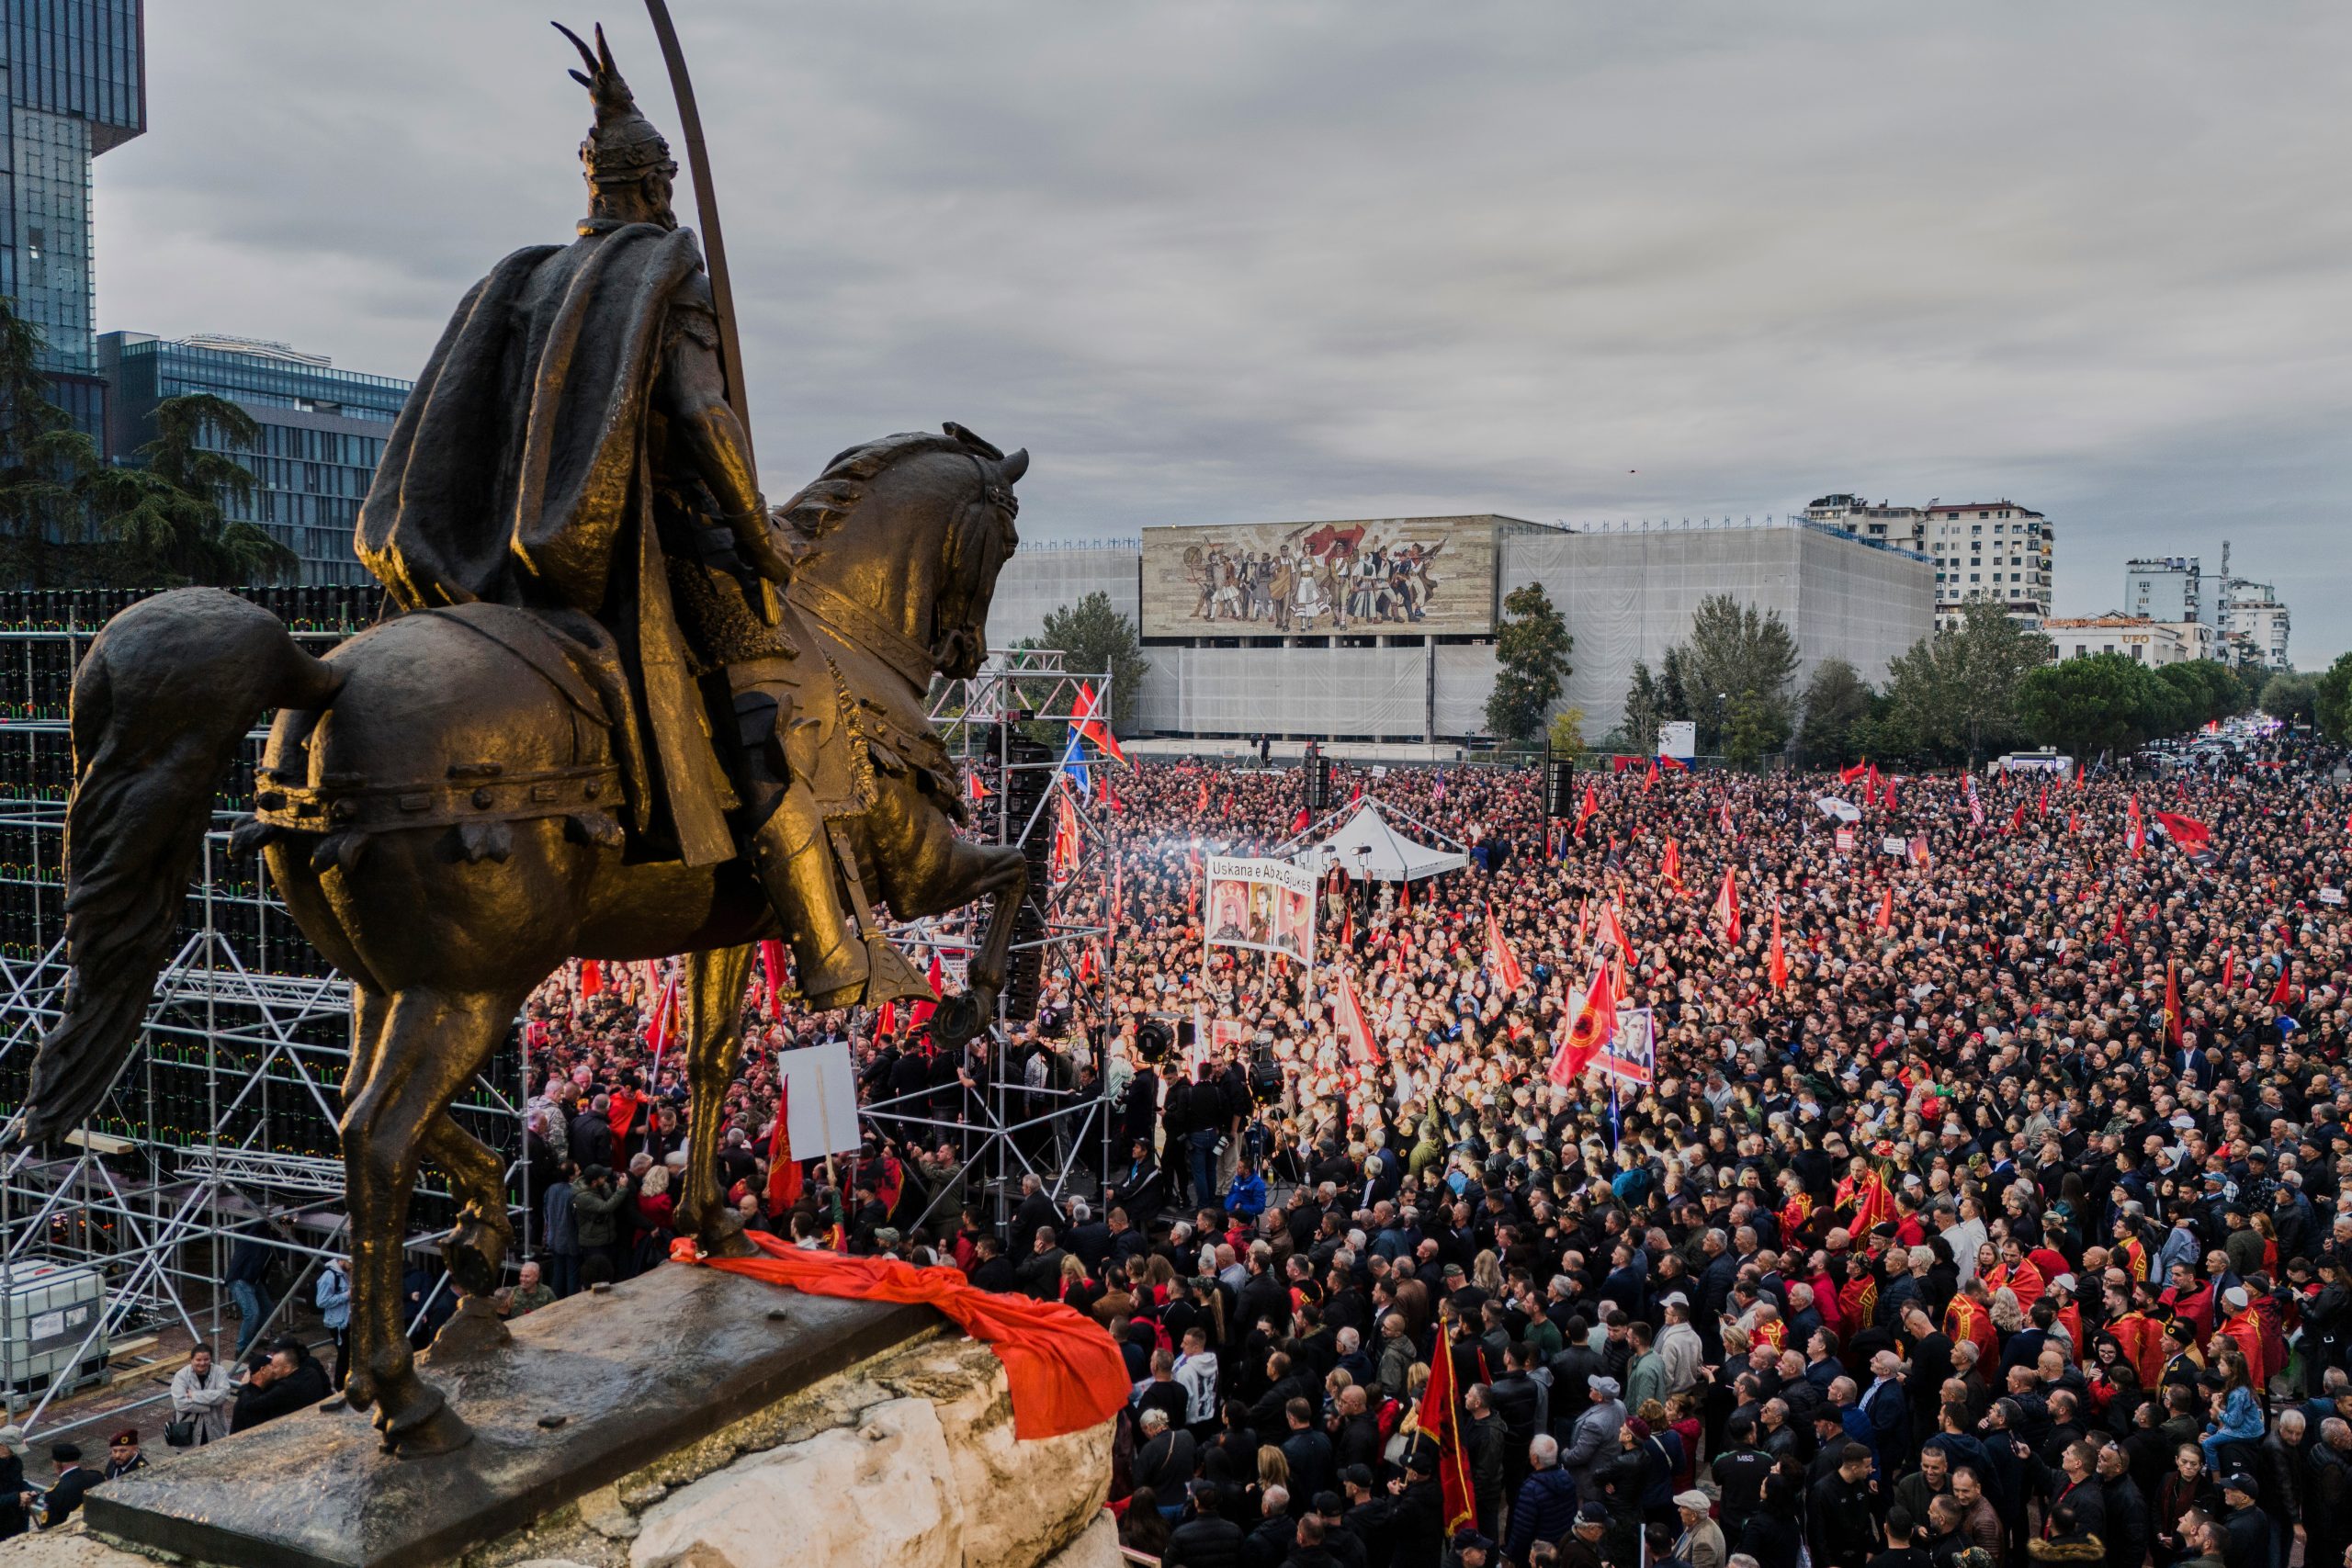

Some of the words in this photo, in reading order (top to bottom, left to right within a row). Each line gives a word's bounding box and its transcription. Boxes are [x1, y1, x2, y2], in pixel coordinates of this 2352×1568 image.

[2122, 635, 2149, 644] UFO
[1213, 861, 1253, 876] Uskana
[1255, 867, 1261, 877] e
